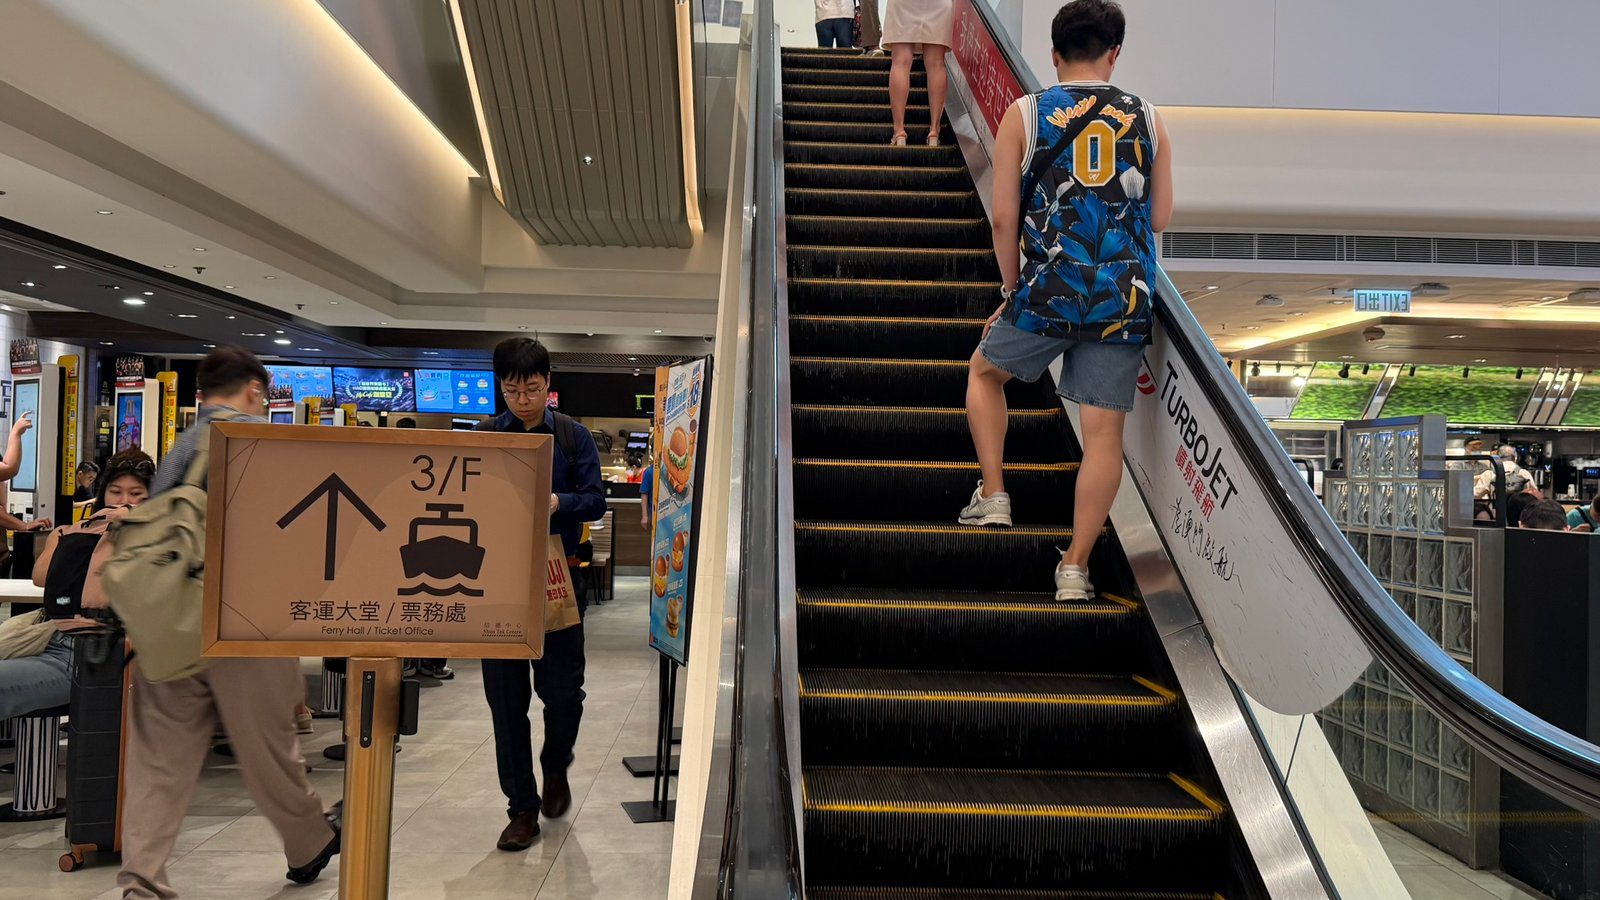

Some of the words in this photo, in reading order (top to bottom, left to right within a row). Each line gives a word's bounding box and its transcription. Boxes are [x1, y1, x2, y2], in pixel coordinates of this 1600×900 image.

[1073, 120, 1116, 187] 0
[410, 455, 481, 495] 3/F
[1175, 443, 1216, 523] 噴射飛航
[547, 559, 566, 585] UJI
[289, 600, 380, 621] 客運大堂
[400, 602, 466, 623] 票務處
[321, 626, 344, 635] Ferry
[347, 626, 365, 634] Hall
[374, 627, 401, 635] Ticket
[404, 626, 434, 635] Office
